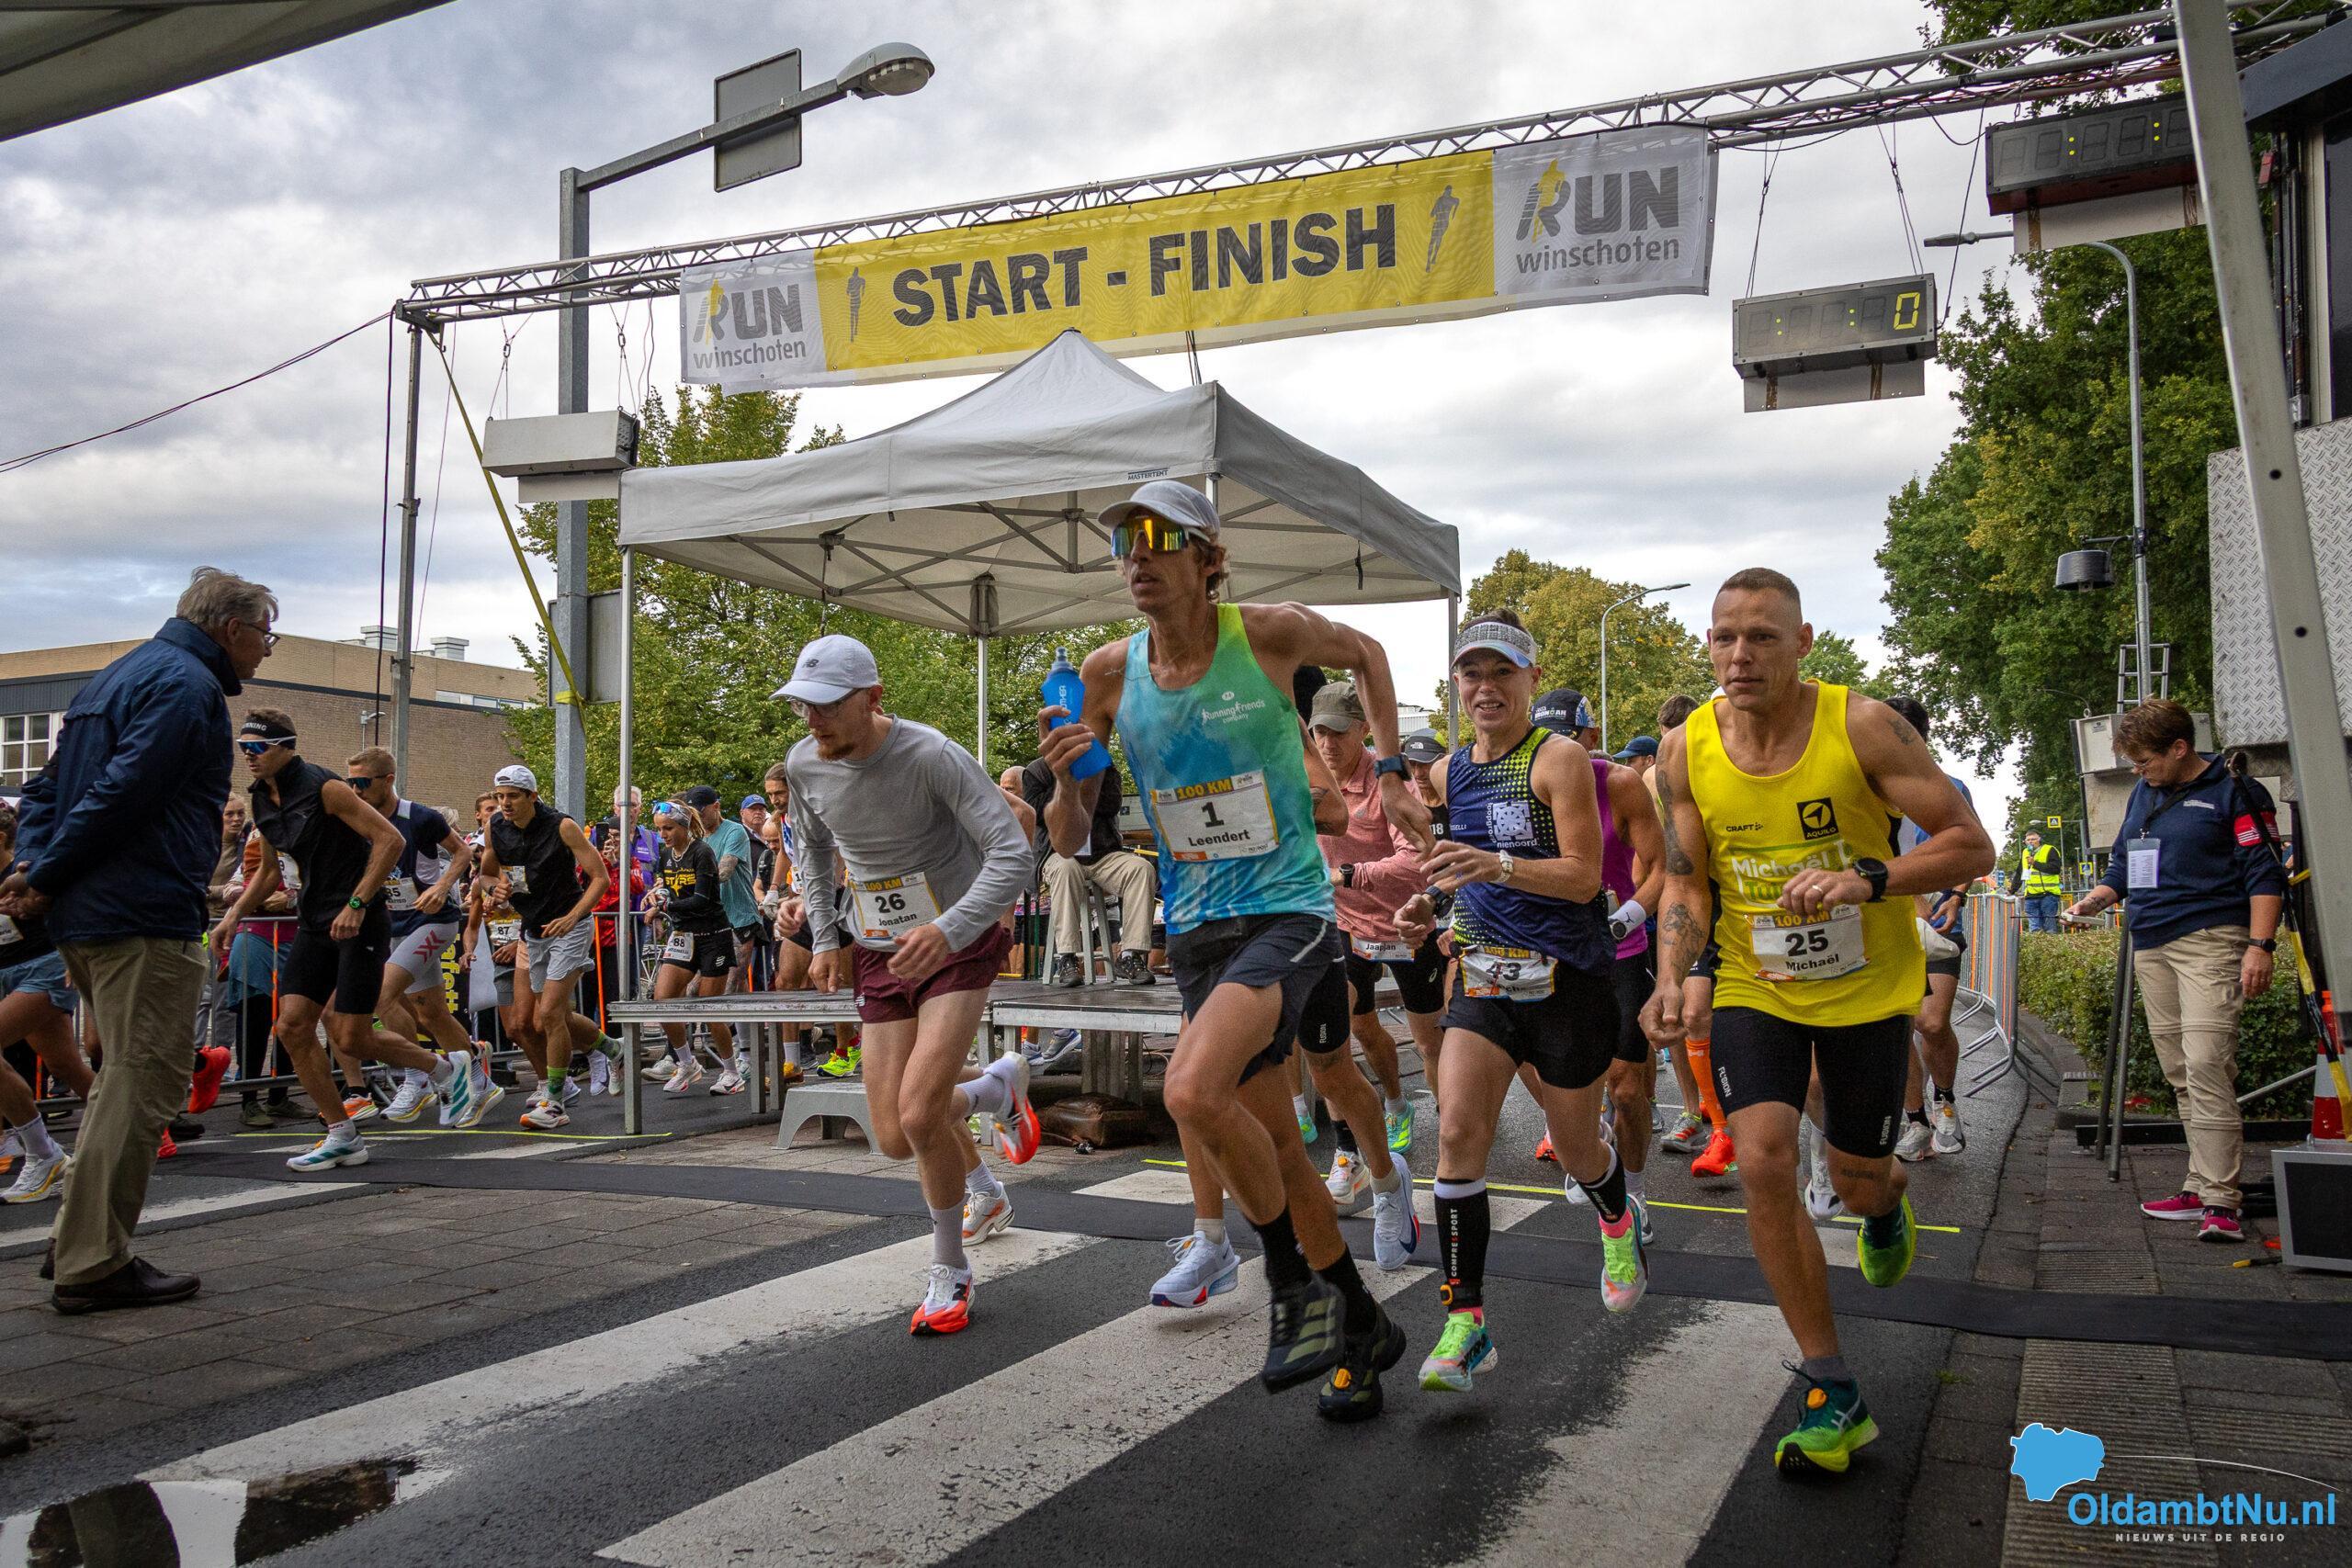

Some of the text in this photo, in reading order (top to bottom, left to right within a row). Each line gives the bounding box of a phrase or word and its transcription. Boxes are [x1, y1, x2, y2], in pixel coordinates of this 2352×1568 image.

[1517, 159, 1679, 243] RUN
[1517, 236, 1679, 275] winschoten
[892, 246, 1088, 328] START
[1148, 204, 1396, 298] FINISH
[693, 279, 804, 344] RUN
[693, 338, 807, 370] winschoten
[1177, 784, 1205, 800] 100
[1206, 778, 1232, 795] KM
[1201, 801, 1225, 828] 1
[1725, 824, 1755, 832] CRAFT
[1805, 827, 1837, 838] AQUILO
[1188, 829, 1251, 847] Leendert
[1497, 838, 1538, 849] nienoord
[1732, 850, 1830, 878] Michaël
[883, 877, 902, 890] KM
[875, 893, 906, 914] 26
[879, 913, 917, 926] Jonatan
[1775, 915, 1802, 927] 100
[497, 926, 510, 935] 87
[673, 938, 685, 947] 88
[1366, 942, 1396, 952] Jaapjan
[1785, 928, 1829, 957] 25
[1508, 948, 1530, 959] KM
[1785, 953, 1839, 972] Michaël
[1486, 962, 1522, 981] 43
[1718, 1066, 1732, 1098] FUSION
[1451, 1208, 1459, 1278] COMPRESSPORT
